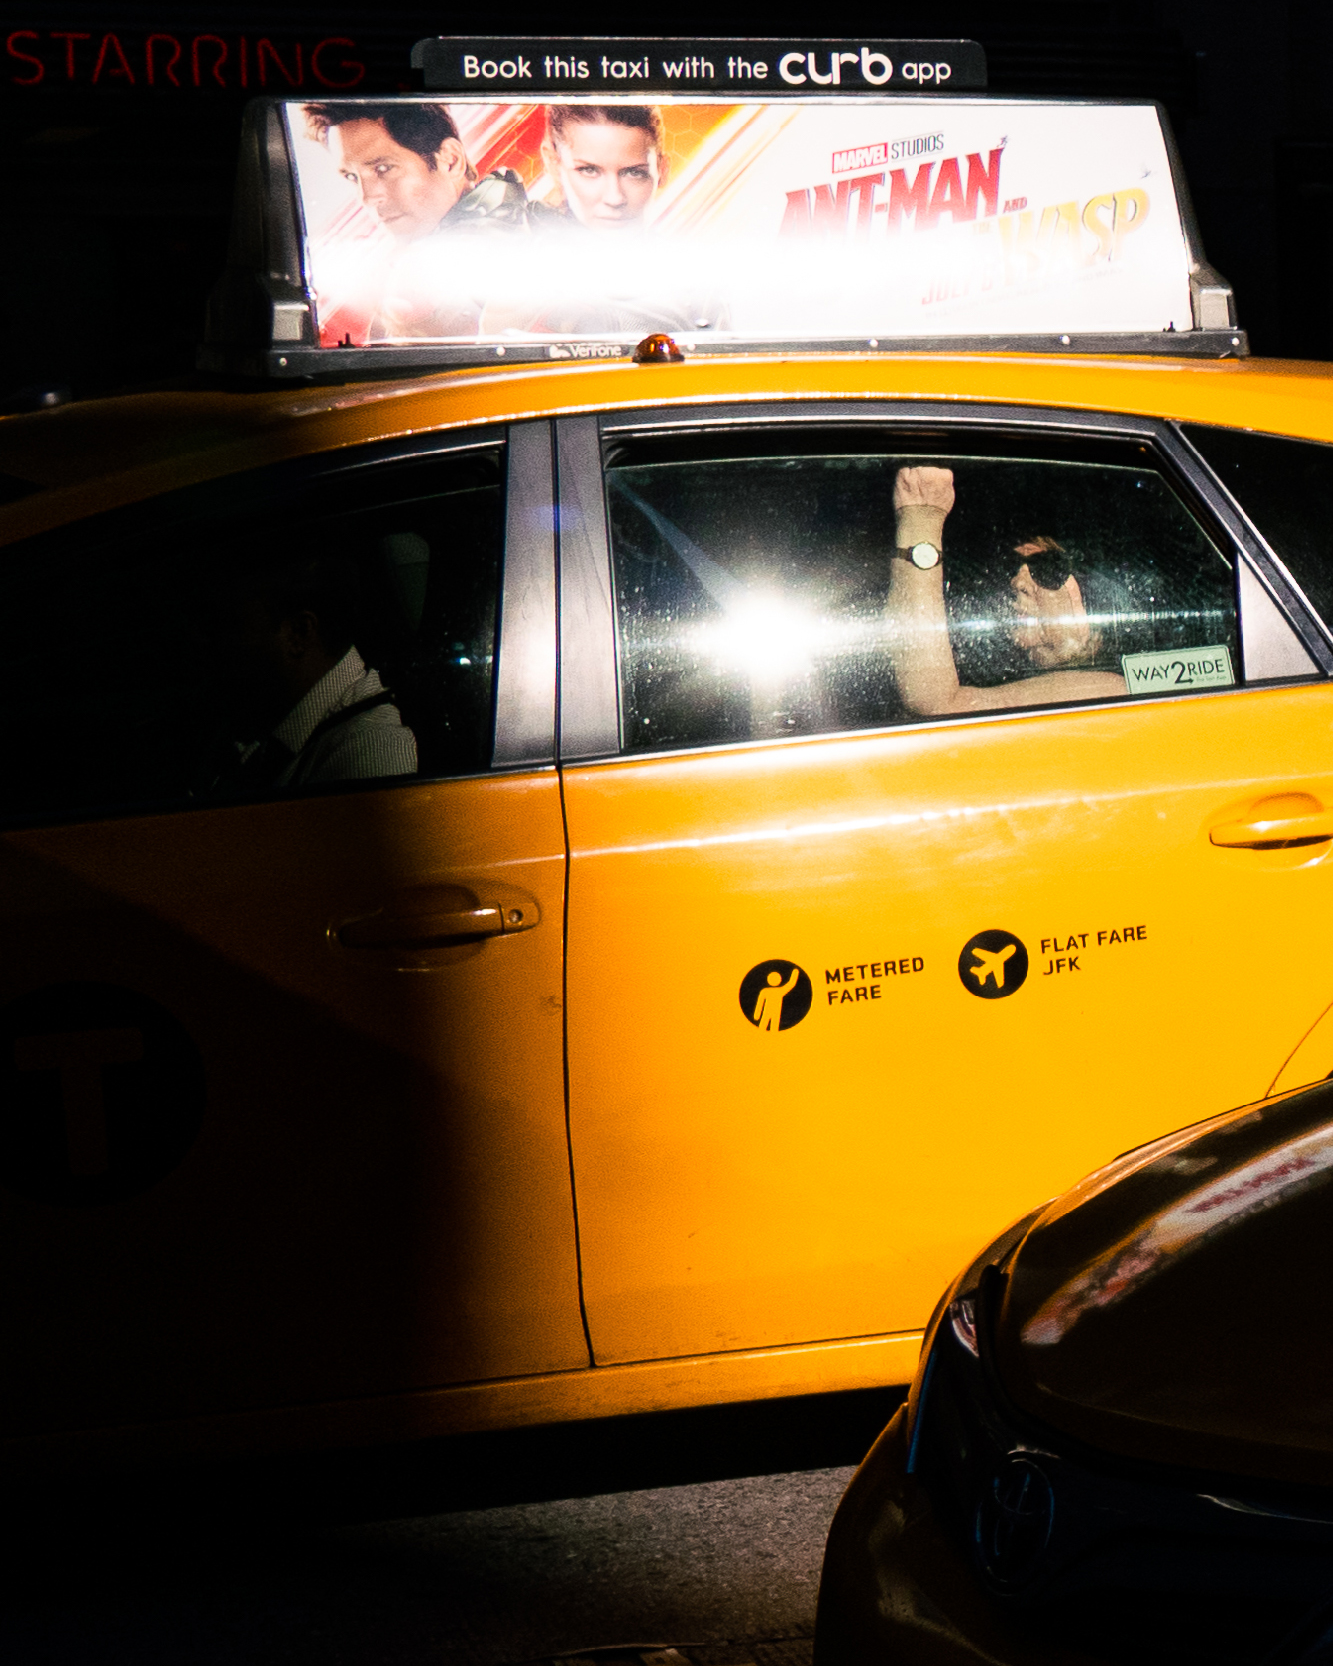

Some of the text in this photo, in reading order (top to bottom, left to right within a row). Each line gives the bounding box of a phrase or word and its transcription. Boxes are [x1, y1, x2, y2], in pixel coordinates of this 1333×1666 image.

[6, 30, 366, 89] STARRING
[463, 46, 952, 85] Book this taxi with the curb app
[832, 133, 945, 174] MARVEL STUDIOS
[780, 146, 1005, 243] ANT-MAN
[1003, 196, 1028, 214] AND
[999, 186, 1151, 286] WASP
[1040, 924, 1149, 955] FLAT FARE
[825, 956, 925, 985] METERED
[1042, 957, 1082, 976] JFK
[828, 984, 883, 1006] FARE
[13, 1026, 145, 1177] T
